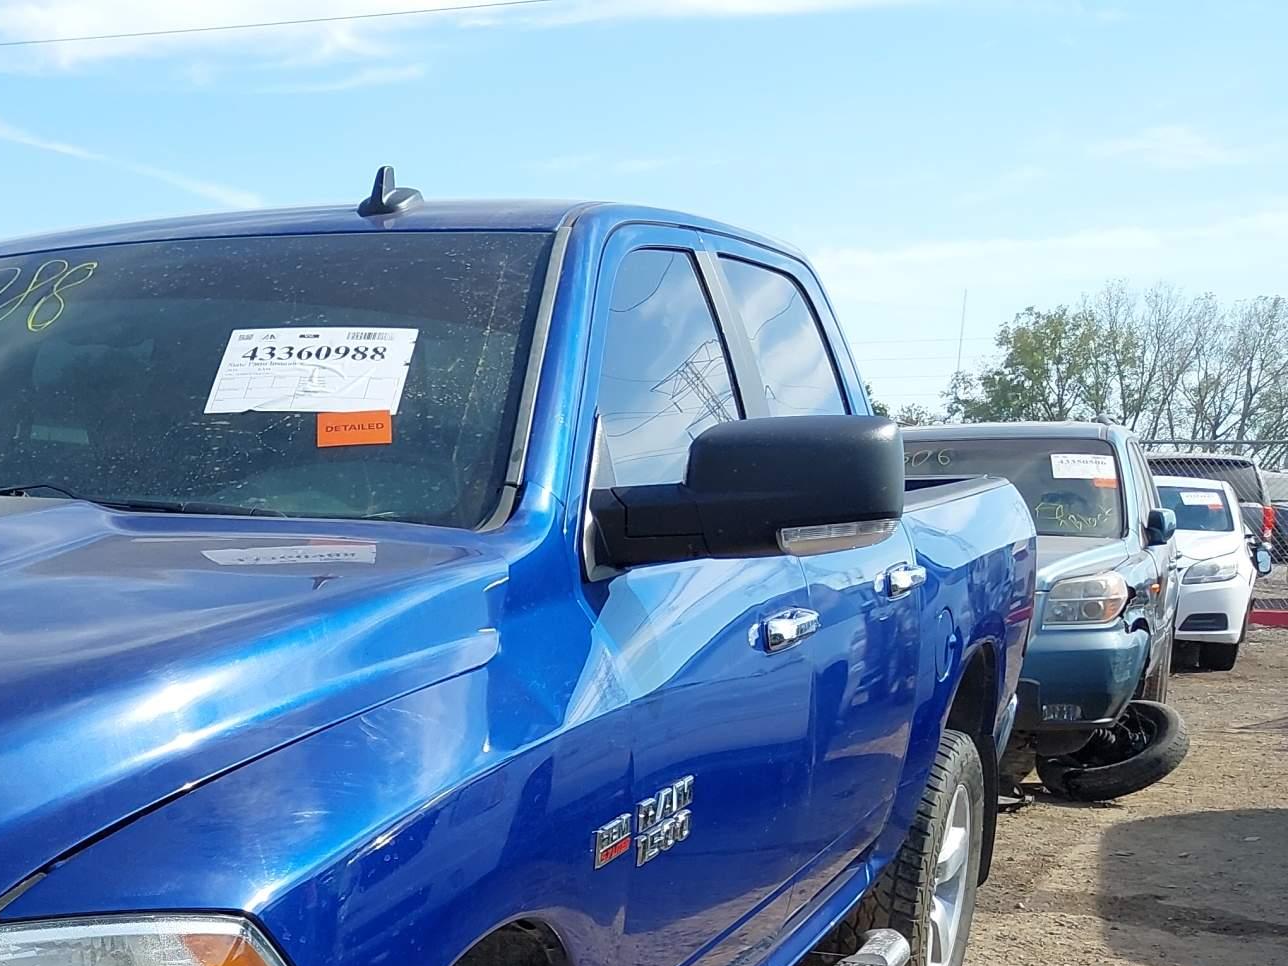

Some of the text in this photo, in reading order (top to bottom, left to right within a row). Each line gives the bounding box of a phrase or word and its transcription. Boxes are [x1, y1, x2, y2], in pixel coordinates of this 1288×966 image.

[242, 345, 388, 361] 43360988
[325, 422, 385, 433] DETAILED
[634, 808, 691, 867] 1500
